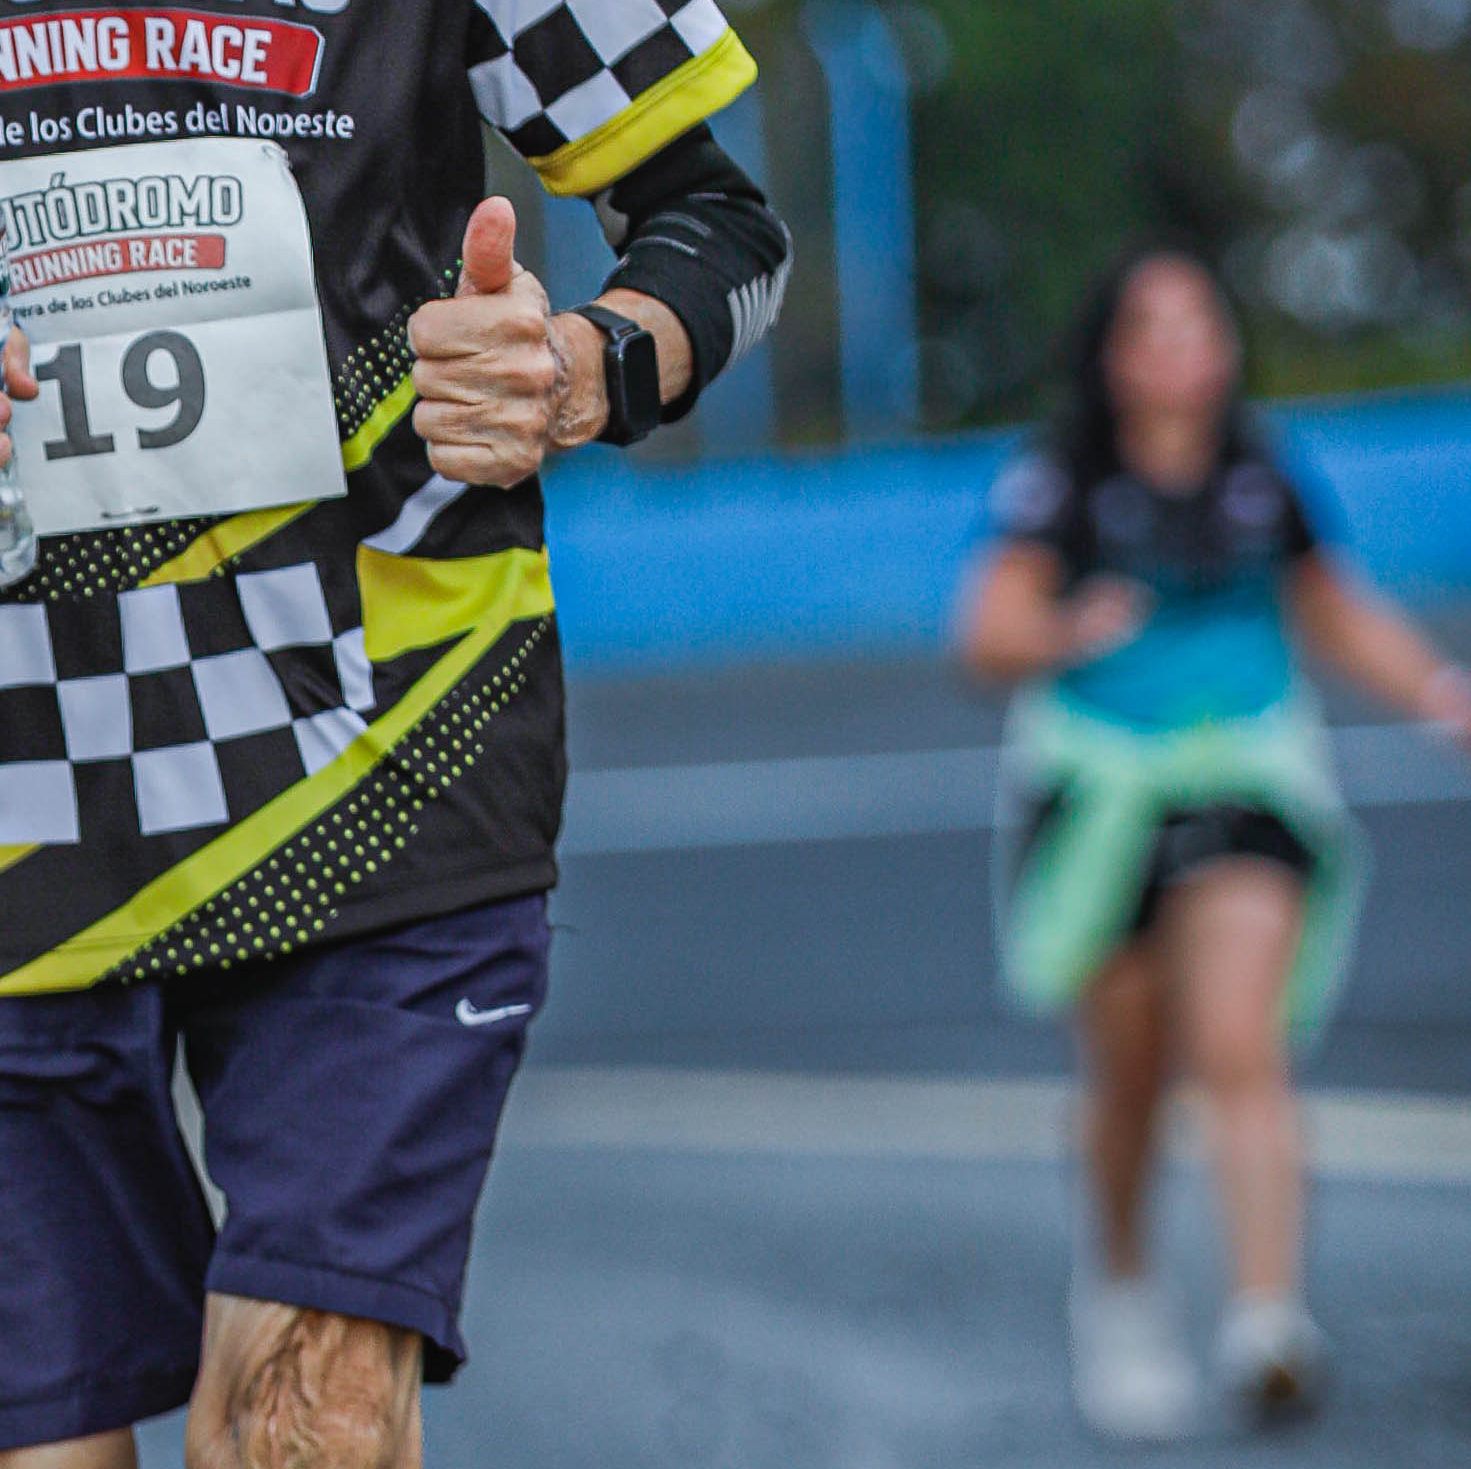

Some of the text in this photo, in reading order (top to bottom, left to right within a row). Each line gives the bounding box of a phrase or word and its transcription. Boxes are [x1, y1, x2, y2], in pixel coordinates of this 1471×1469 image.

[145, 17, 273, 84] RACE
[29, 110, 73, 144] los
[76, 102, 178, 139] Clubes
[184, 101, 230, 133] del
[2, 171, 243, 250] TÓDROMO
[9, 241, 123, 293] RUNNING
[128, 238, 200, 274] RACE
[47, 296, 69, 314] de
[71, 294, 94, 311] los
[97, 288, 150, 308] Clubes
[154, 281, 179, 300] del
[182, 274, 252, 296] Noroeste
[35, 329, 206, 461] 19
